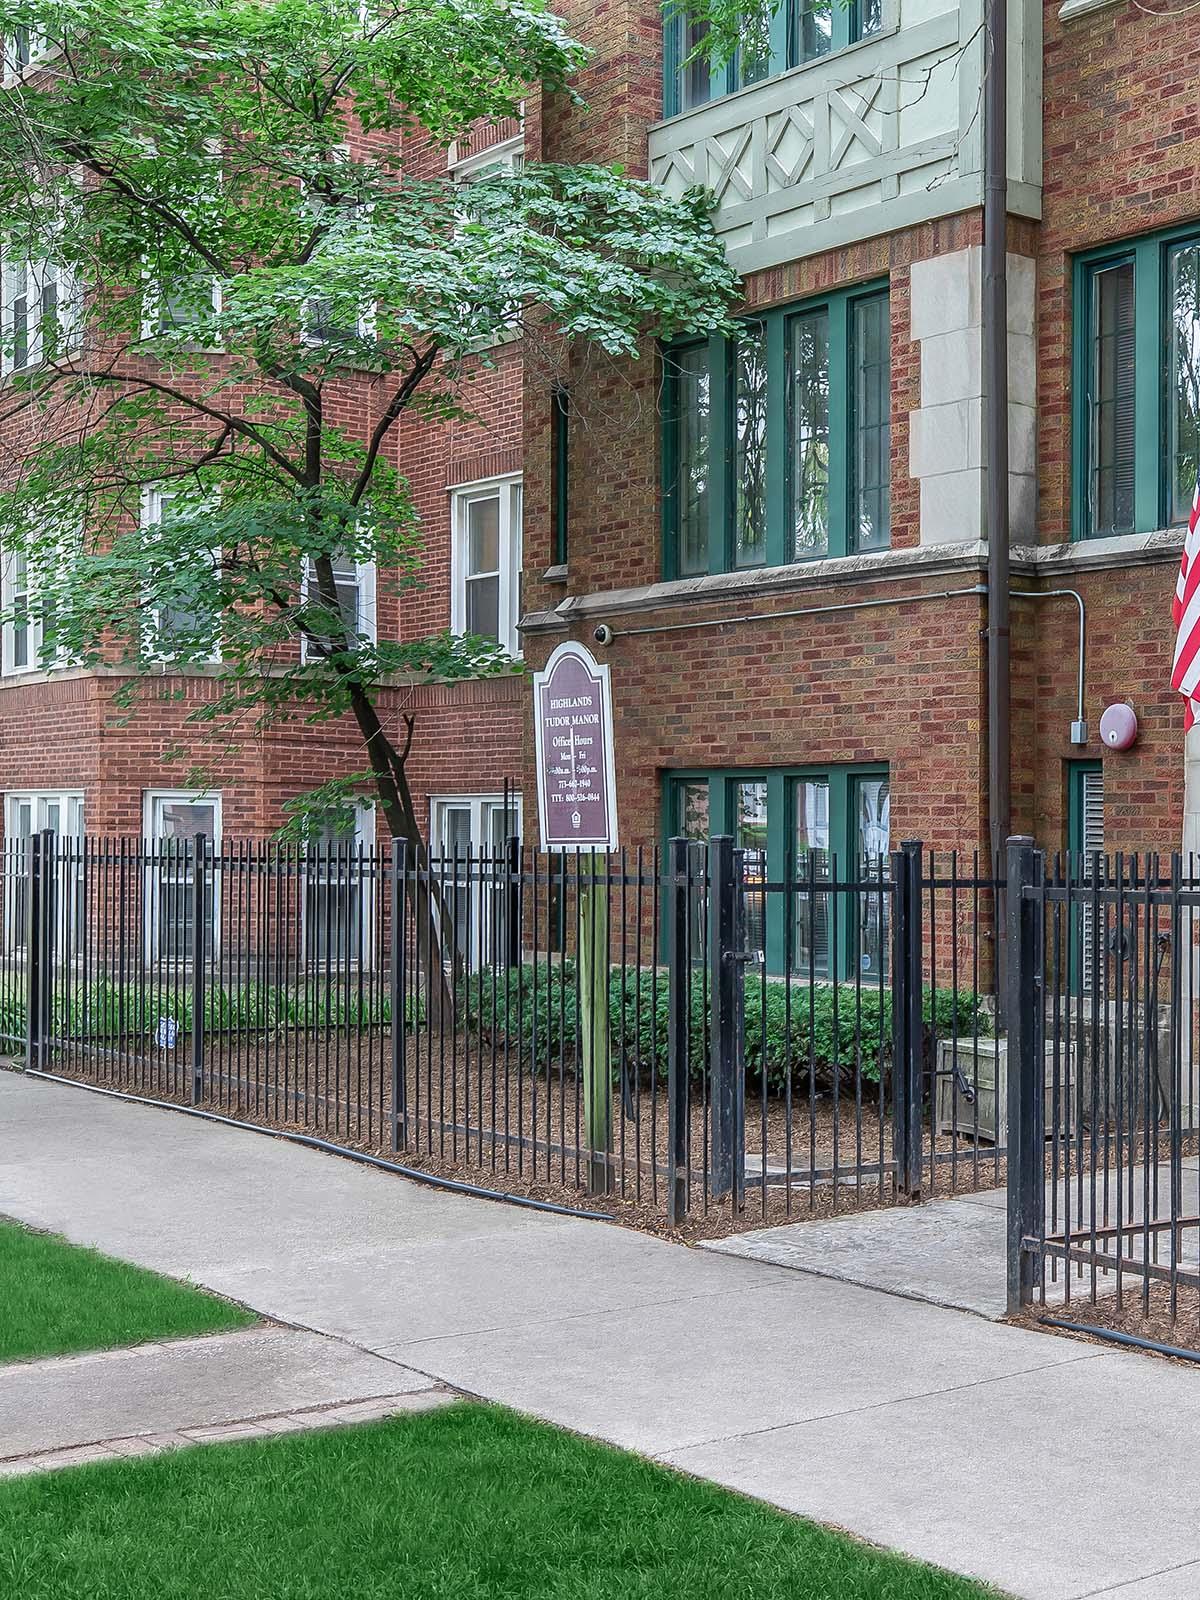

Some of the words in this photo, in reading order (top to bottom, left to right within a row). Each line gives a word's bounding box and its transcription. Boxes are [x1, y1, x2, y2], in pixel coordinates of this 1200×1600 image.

[550, 695, 593, 710] HIGHLANDS
[545, 716, 570, 728] TUDOR
[571, 713, 600, 726] MANOR
[574, 734, 593, 746] Hours
[560, 751, 571, 761] Mon
[578, 750, 586, 760] Fri
